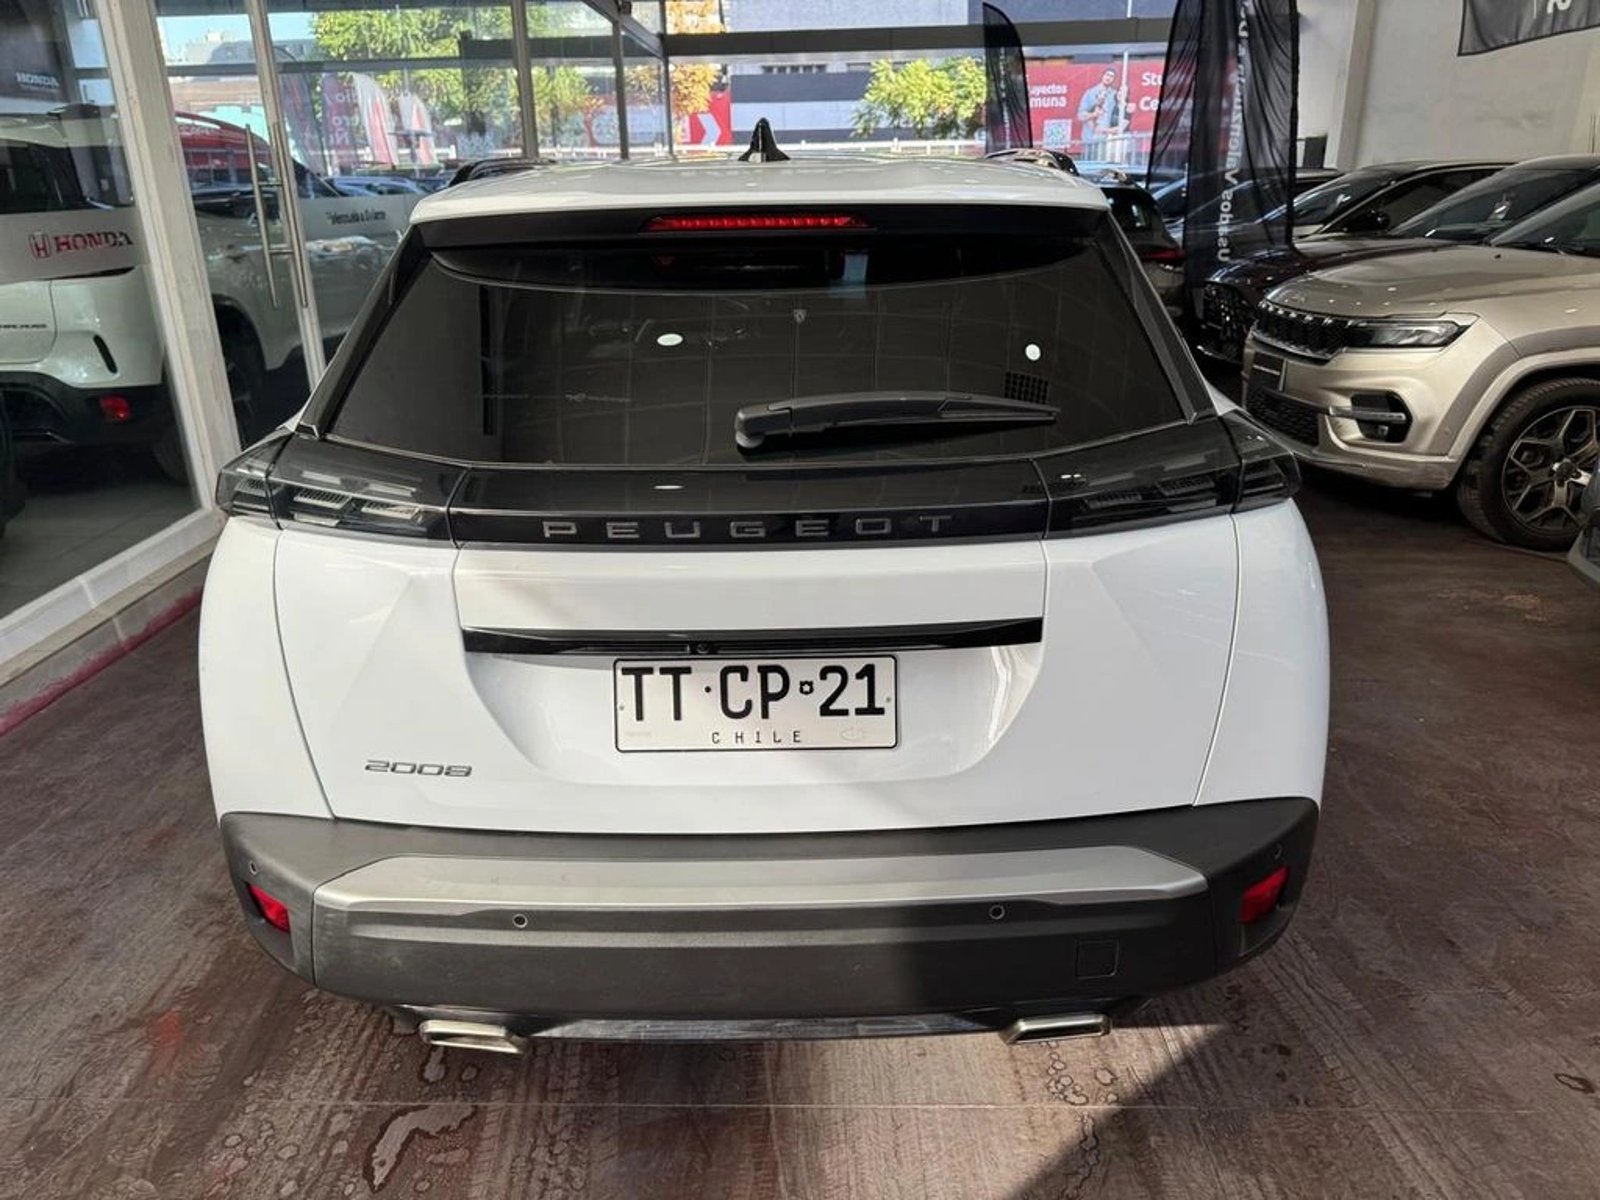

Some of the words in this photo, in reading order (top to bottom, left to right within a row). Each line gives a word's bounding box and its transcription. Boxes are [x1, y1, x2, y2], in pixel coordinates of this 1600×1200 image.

[1029, 95, 1067, 108] muna
[54, 231, 134, 252] HONDA
[542, 515, 952, 539] PEUGEOT
[711, 730, 802, 744] CHILE
[364, 759, 473, 777] 2008
